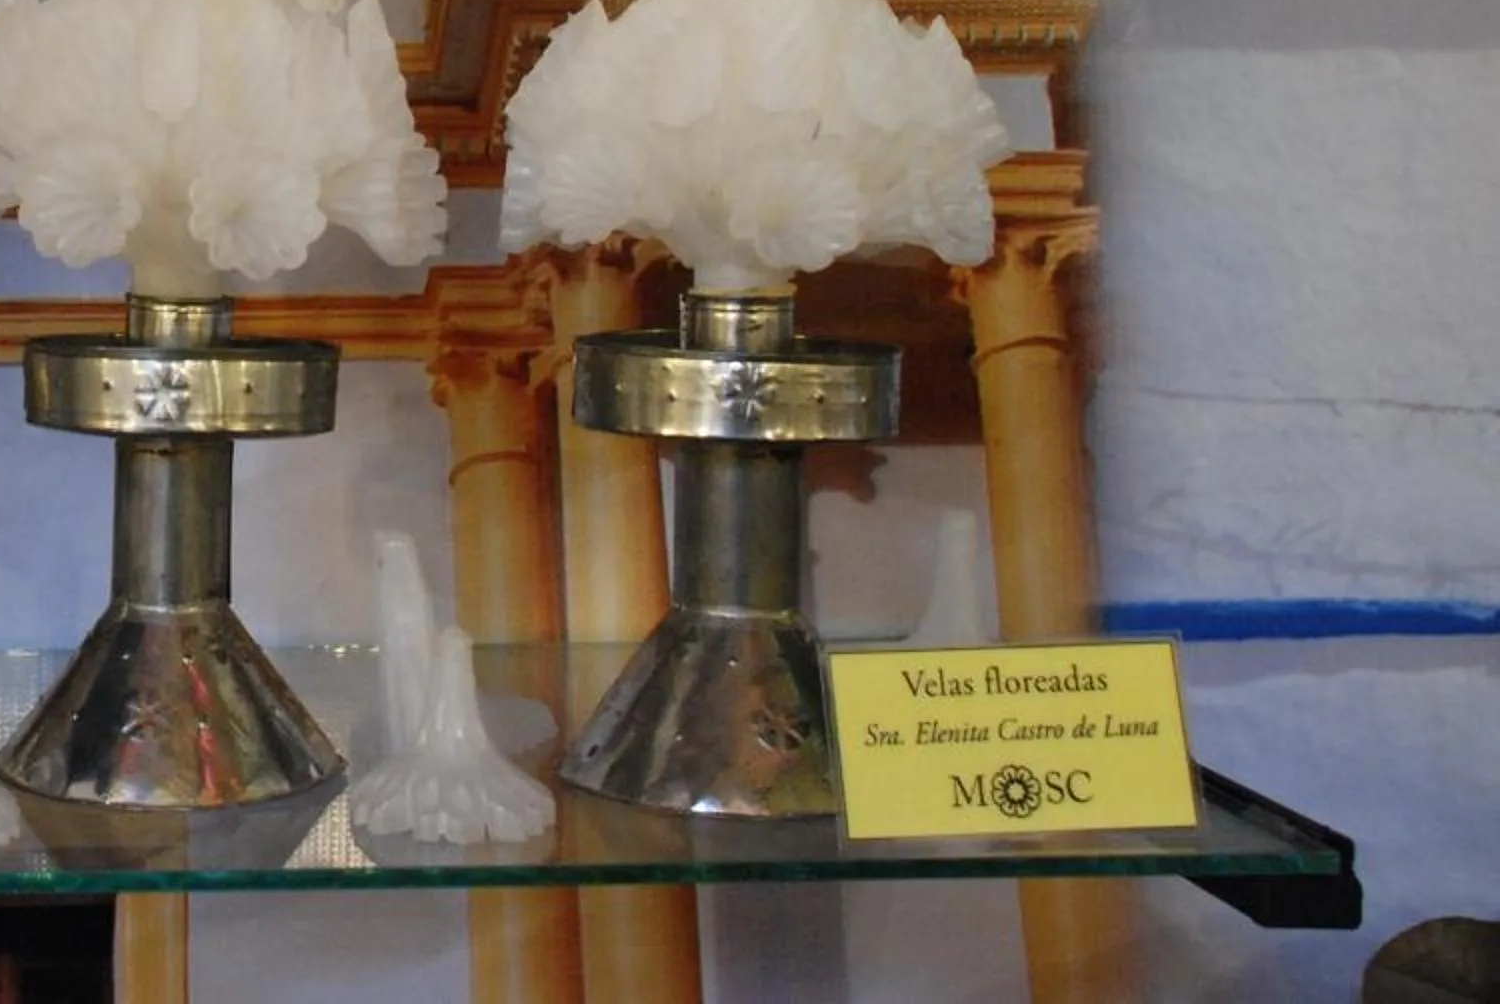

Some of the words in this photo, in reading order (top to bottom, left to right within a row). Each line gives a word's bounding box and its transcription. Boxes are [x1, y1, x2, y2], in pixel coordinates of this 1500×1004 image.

[901, 670, 974, 697] Velas
[984, 664, 1108, 694] floreadas
[864, 724, 904, 746] Sra.
[915, 722, 989, 744] Elenita
[998, 718, 1064, 741] Castro
[1072, 715, 1096, 739] de
[1104, 715, 1158, 738] Luna
